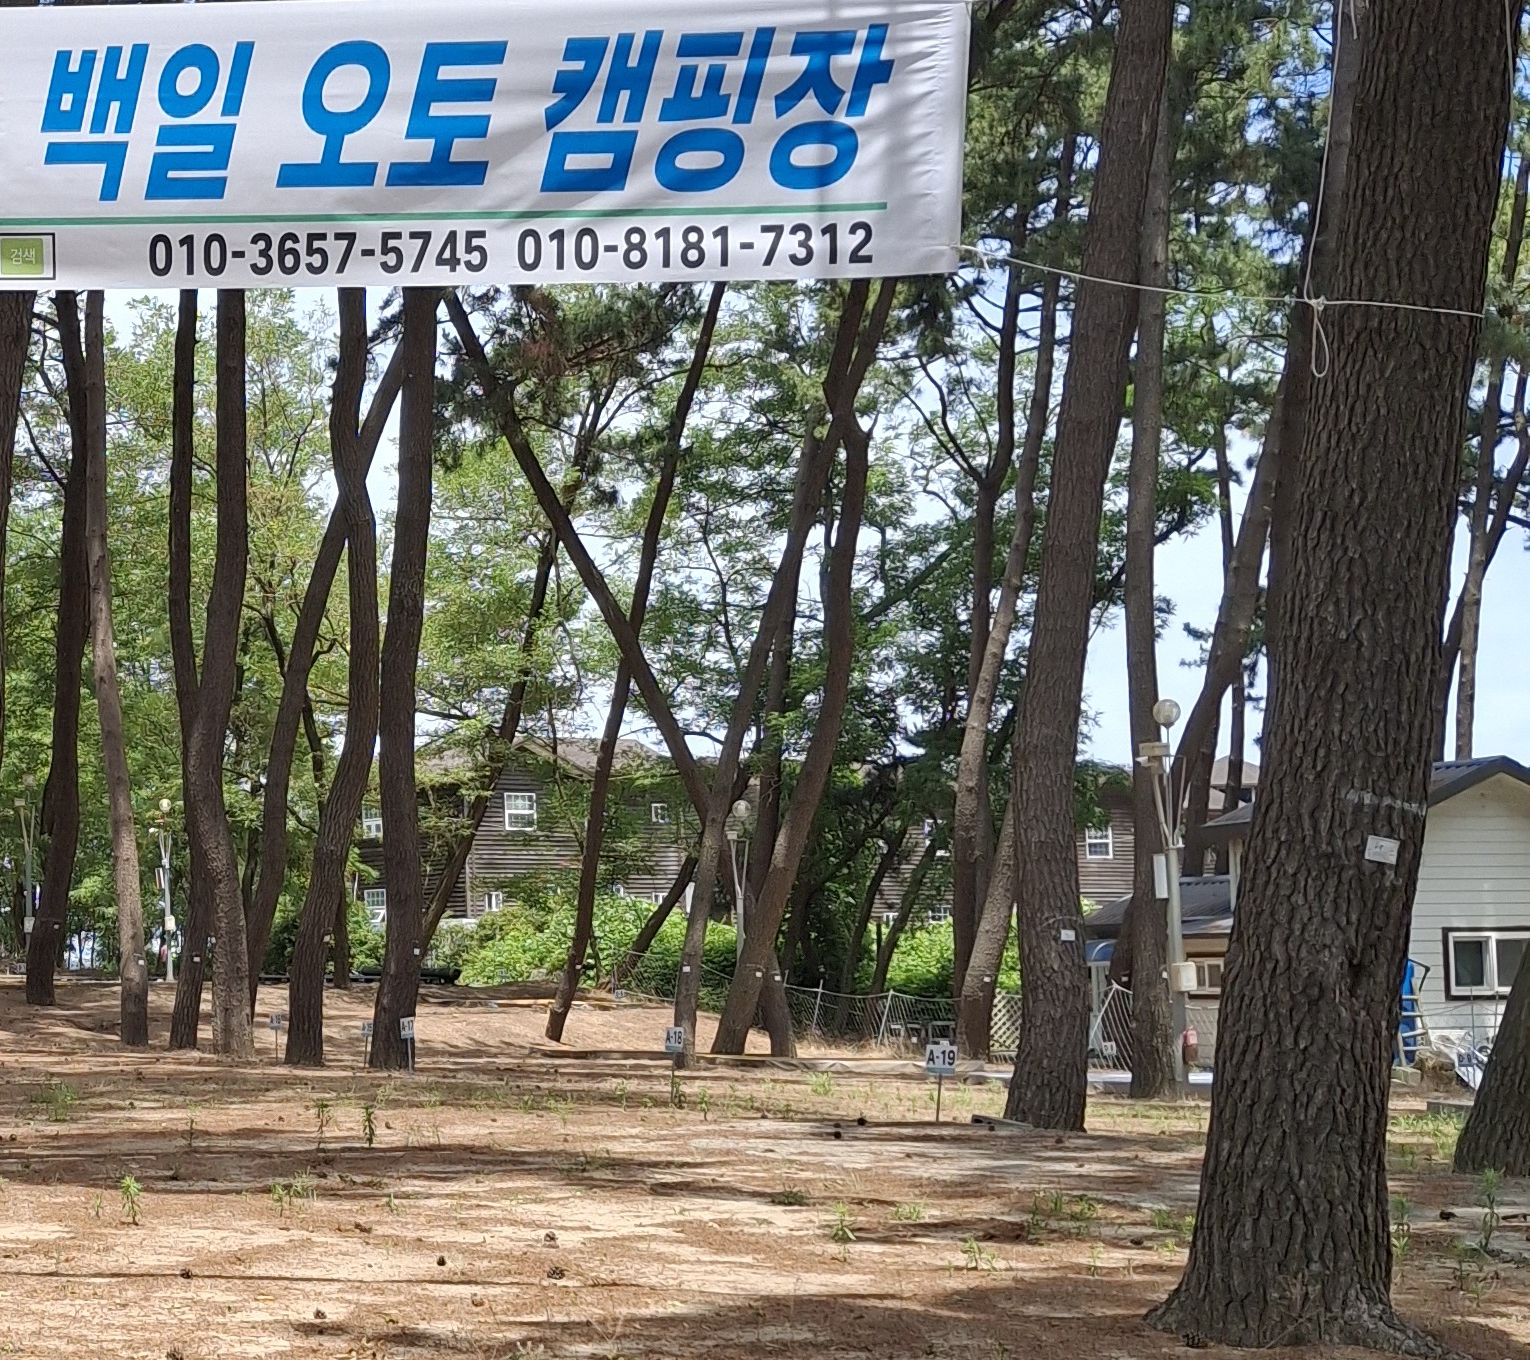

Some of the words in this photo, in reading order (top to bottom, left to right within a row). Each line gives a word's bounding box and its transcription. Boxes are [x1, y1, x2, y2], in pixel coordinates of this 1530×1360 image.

[40, 40, 256, 202] 백일
[276, 40, 508, 189] 오토
[540, 23, 895, 193] 캠핑장
[10, 248, 36, 265] 검색
[148, 229, 489, 278] 010-3657-5745
[516, 221, 874, 273] 010-8181-7312
[665, 1030, 683, 1045] A-18
[927, 1049, 956, 1067] A-19
